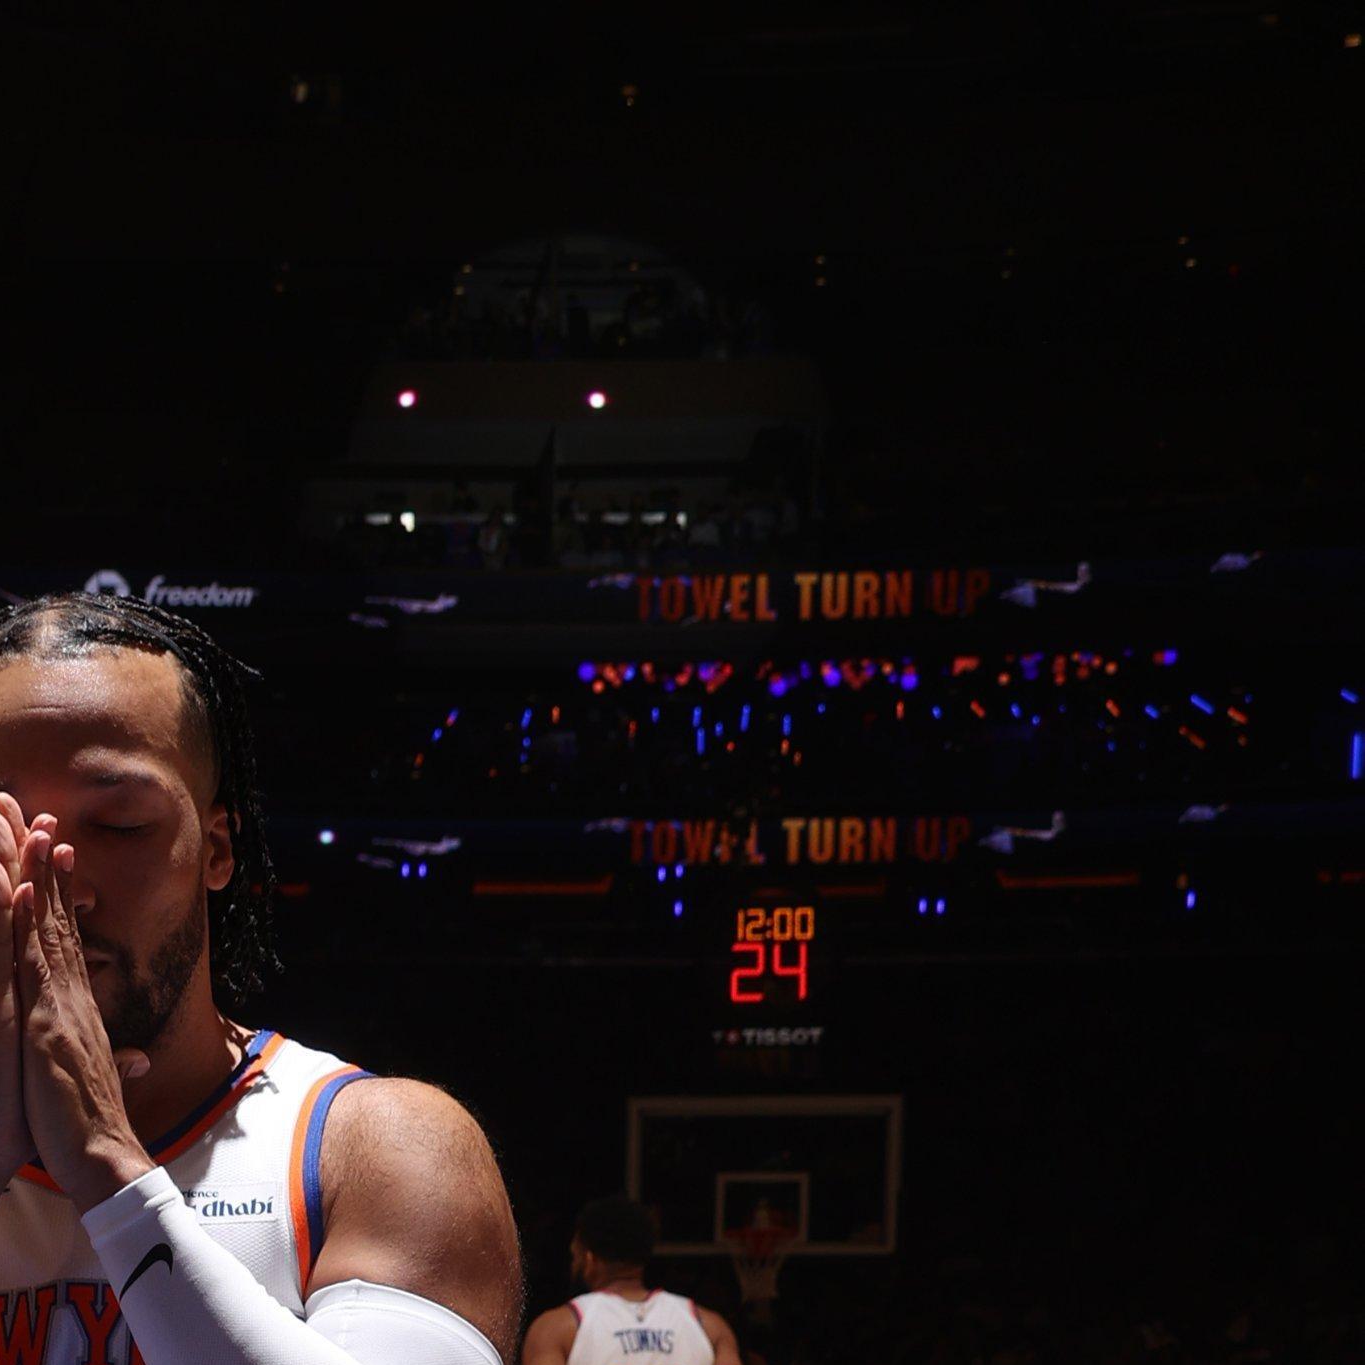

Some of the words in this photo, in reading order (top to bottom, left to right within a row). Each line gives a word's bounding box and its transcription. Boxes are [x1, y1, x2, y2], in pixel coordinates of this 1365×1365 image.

[145, 575, 254, 607] freedom
[635, 572, 776, 622] TOWEL
[795, 571, 913, 620] TURN
[932, 569, 991, 618] UP
[782, 818, 897, 863] TURN
[914, 818, 970, 861] UP
[737, 906, 815, 941] 12:00
[730, 942, 808, 1003] 24
[742, 1027, 825, 1045] TISSOT
[182, 1189, 219, 1198] rience
[614, 1328, 675, 1355] TOWNS
